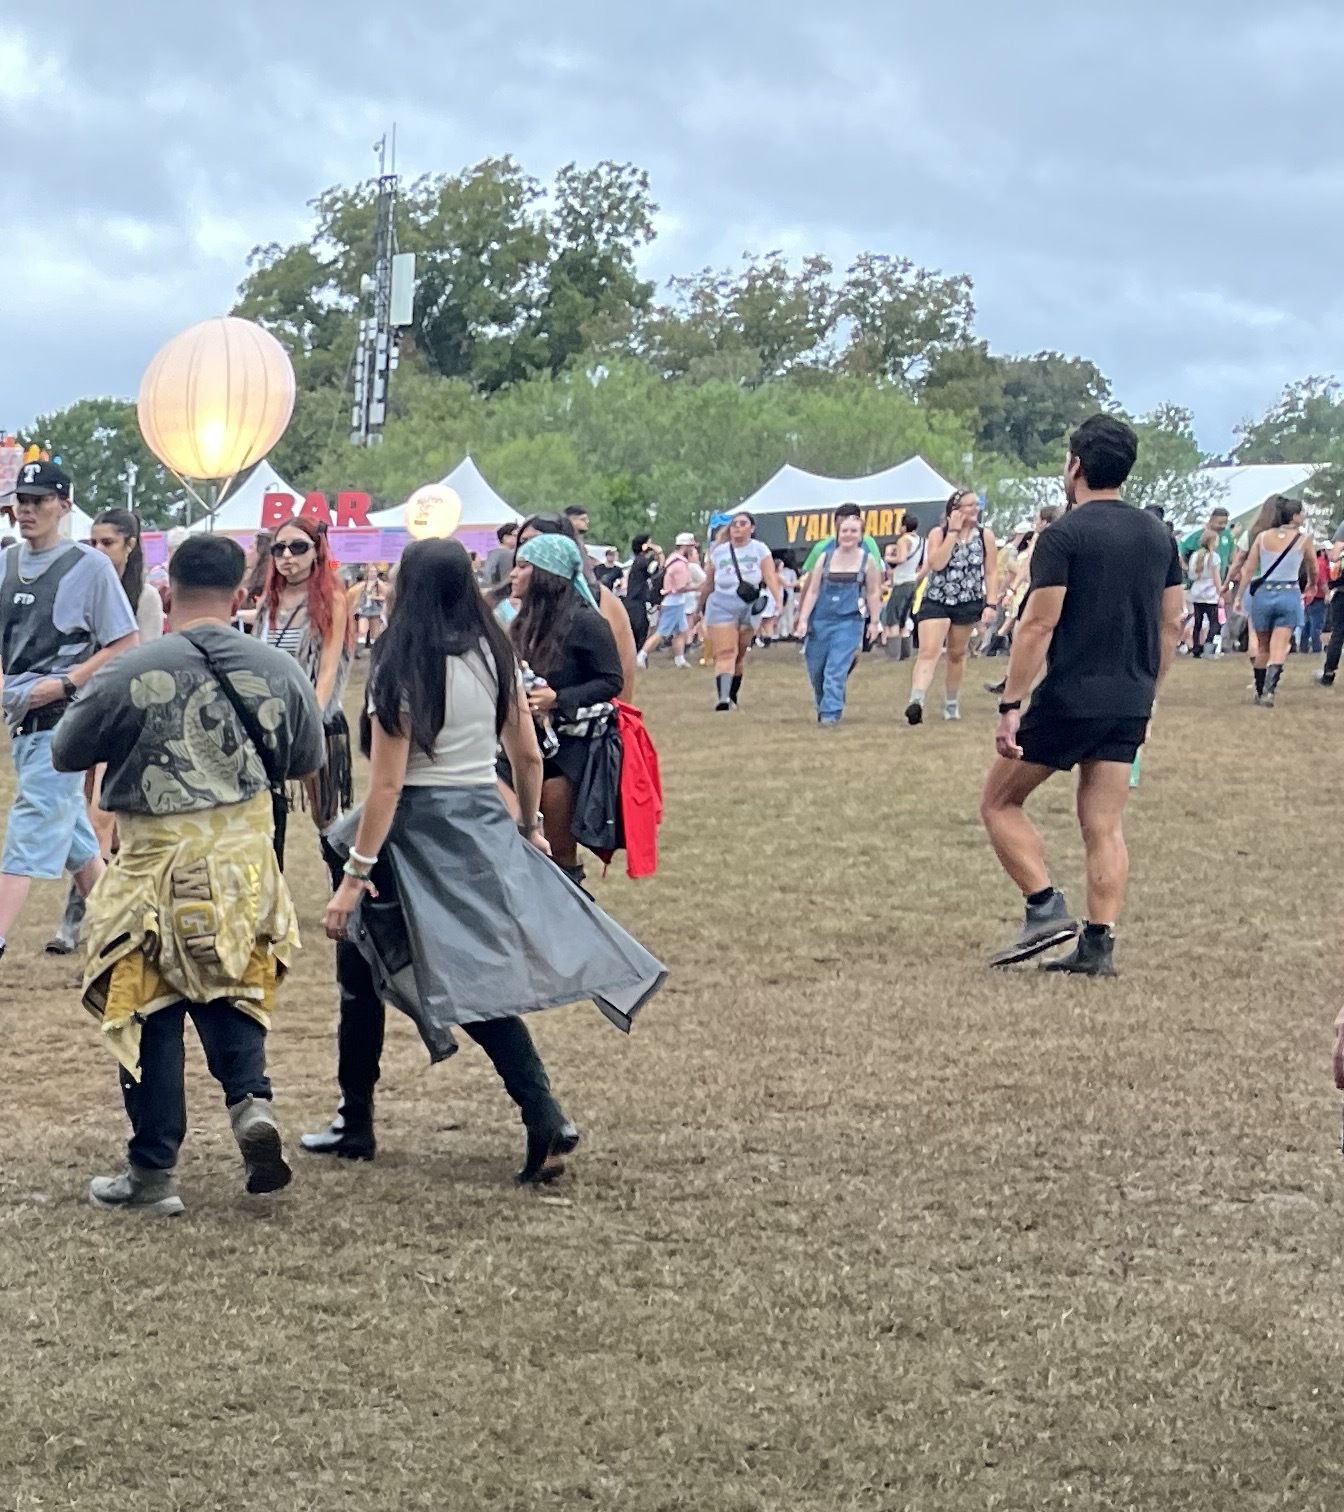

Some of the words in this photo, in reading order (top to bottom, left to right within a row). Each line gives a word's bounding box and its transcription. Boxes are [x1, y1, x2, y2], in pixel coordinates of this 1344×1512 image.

[24, 463, 42, 483] T
[261, 491, 372, 530] BAR
[861, 508, 906, 536] ART
